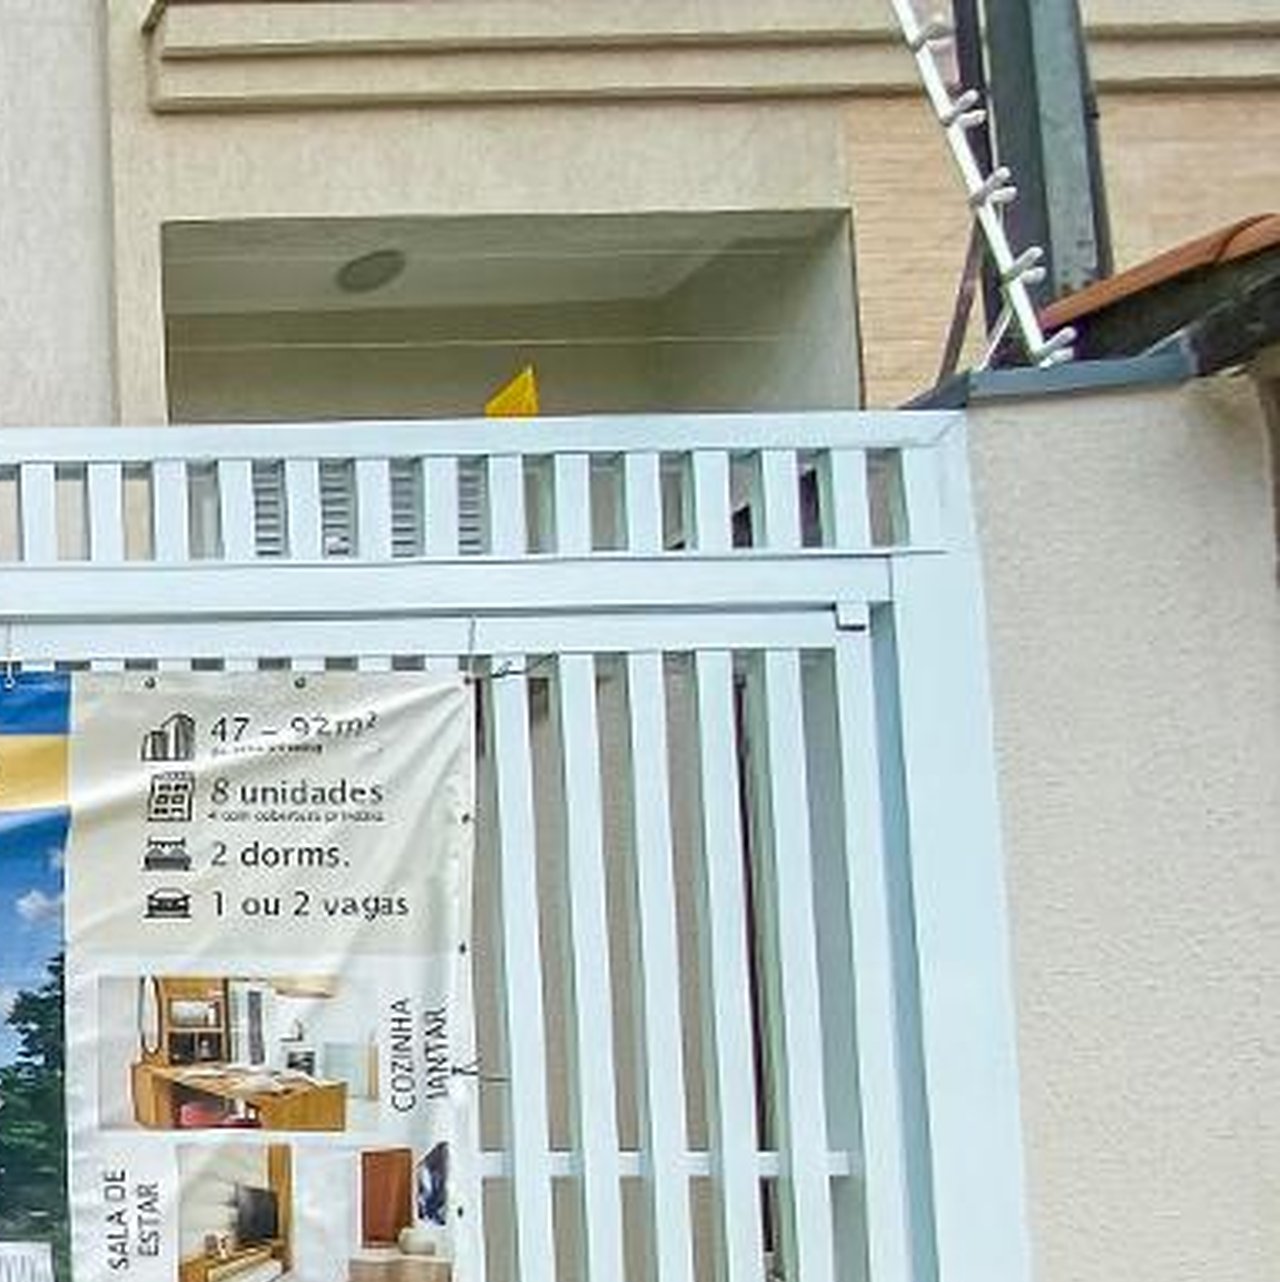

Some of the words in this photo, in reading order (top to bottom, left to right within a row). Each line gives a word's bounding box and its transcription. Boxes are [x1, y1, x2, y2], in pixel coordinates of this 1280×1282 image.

[211, 716, 250, 742] 47
[211, 777, 230, 805] 8
[241, 778, 384, 805] unidades
[211, 841, 228, 867] 2
[240, 840, 351, 868] dorms.
[214, 891, 223, 917] 1
[242, 897, 280, 917] ou
[293, 890, 310, 917] 2
[323, 896, 409, 922] vagas
[391, 998, 416, 1112] COZINHA
[104, 1170, 126, 1201] DE
[138, 1183, 160, 1256] ESTAR
[107, 1208, 129, 1270] SALA
